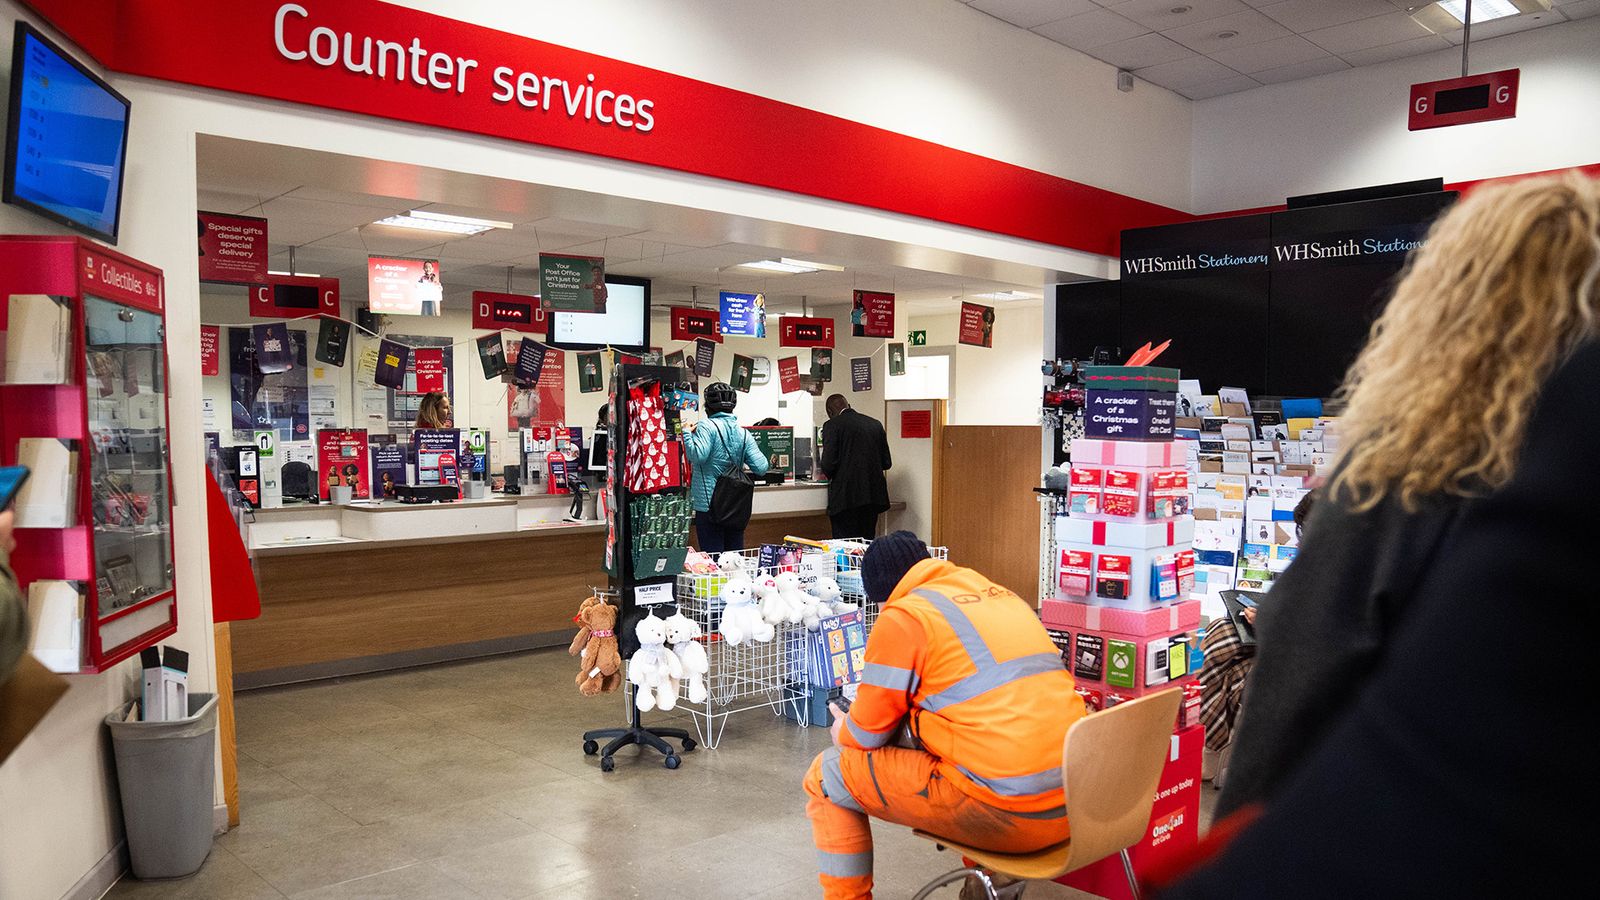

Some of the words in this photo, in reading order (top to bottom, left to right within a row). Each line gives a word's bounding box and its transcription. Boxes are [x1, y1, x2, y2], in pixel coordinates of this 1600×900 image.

[274, 3, 479, 94] Counter
[492, 65, 655, 132] services
[1495, 85, 1509, 103] G
[1415, 97, 1427, 113] G
[208, 222, 242, 233] Special
[242, 228, 264, 236] gifts
[218, 232, 255, 242] deserve
[220, 241, 252, 250] special
[1274, 239, 1361, 263] WHSmith
[218, 248, 254, 259] delivery
[556, 262, 570, 270] Your
[1125, 254, 1196, 274] WHSmith
[1198, 253, 1269, 269] Stationery
[101, 262, 143, 295] Collectibles
[561, 269, 581, 277] Office
[547, 282, 580, 290] Christmas
[258, 287, 269, 303] C
[324, 290, 334, 307] C
[479, 303, 489, 317] D
[535, 308, 544, 321] D
[679, 317, 685, 330] E
[714, 321, 720, 333] E
[786, 325, 792, 337] F
[825, 328, 831, 339] F
[1095, 396, 1102, 404] A
[1103, 397, 1139, 405] cracker
[1107, 406, 1117, 414] of
[1092, 415, 1139, 424] Christmas
[1106, 425, 1123, 434] gift
[1077, 641, 1101, 650] ROBLOX
[1160, 789, 1171, 799] one
[1171, 785, 1178, 794] up
[1179, 778, 1194, 790] today
